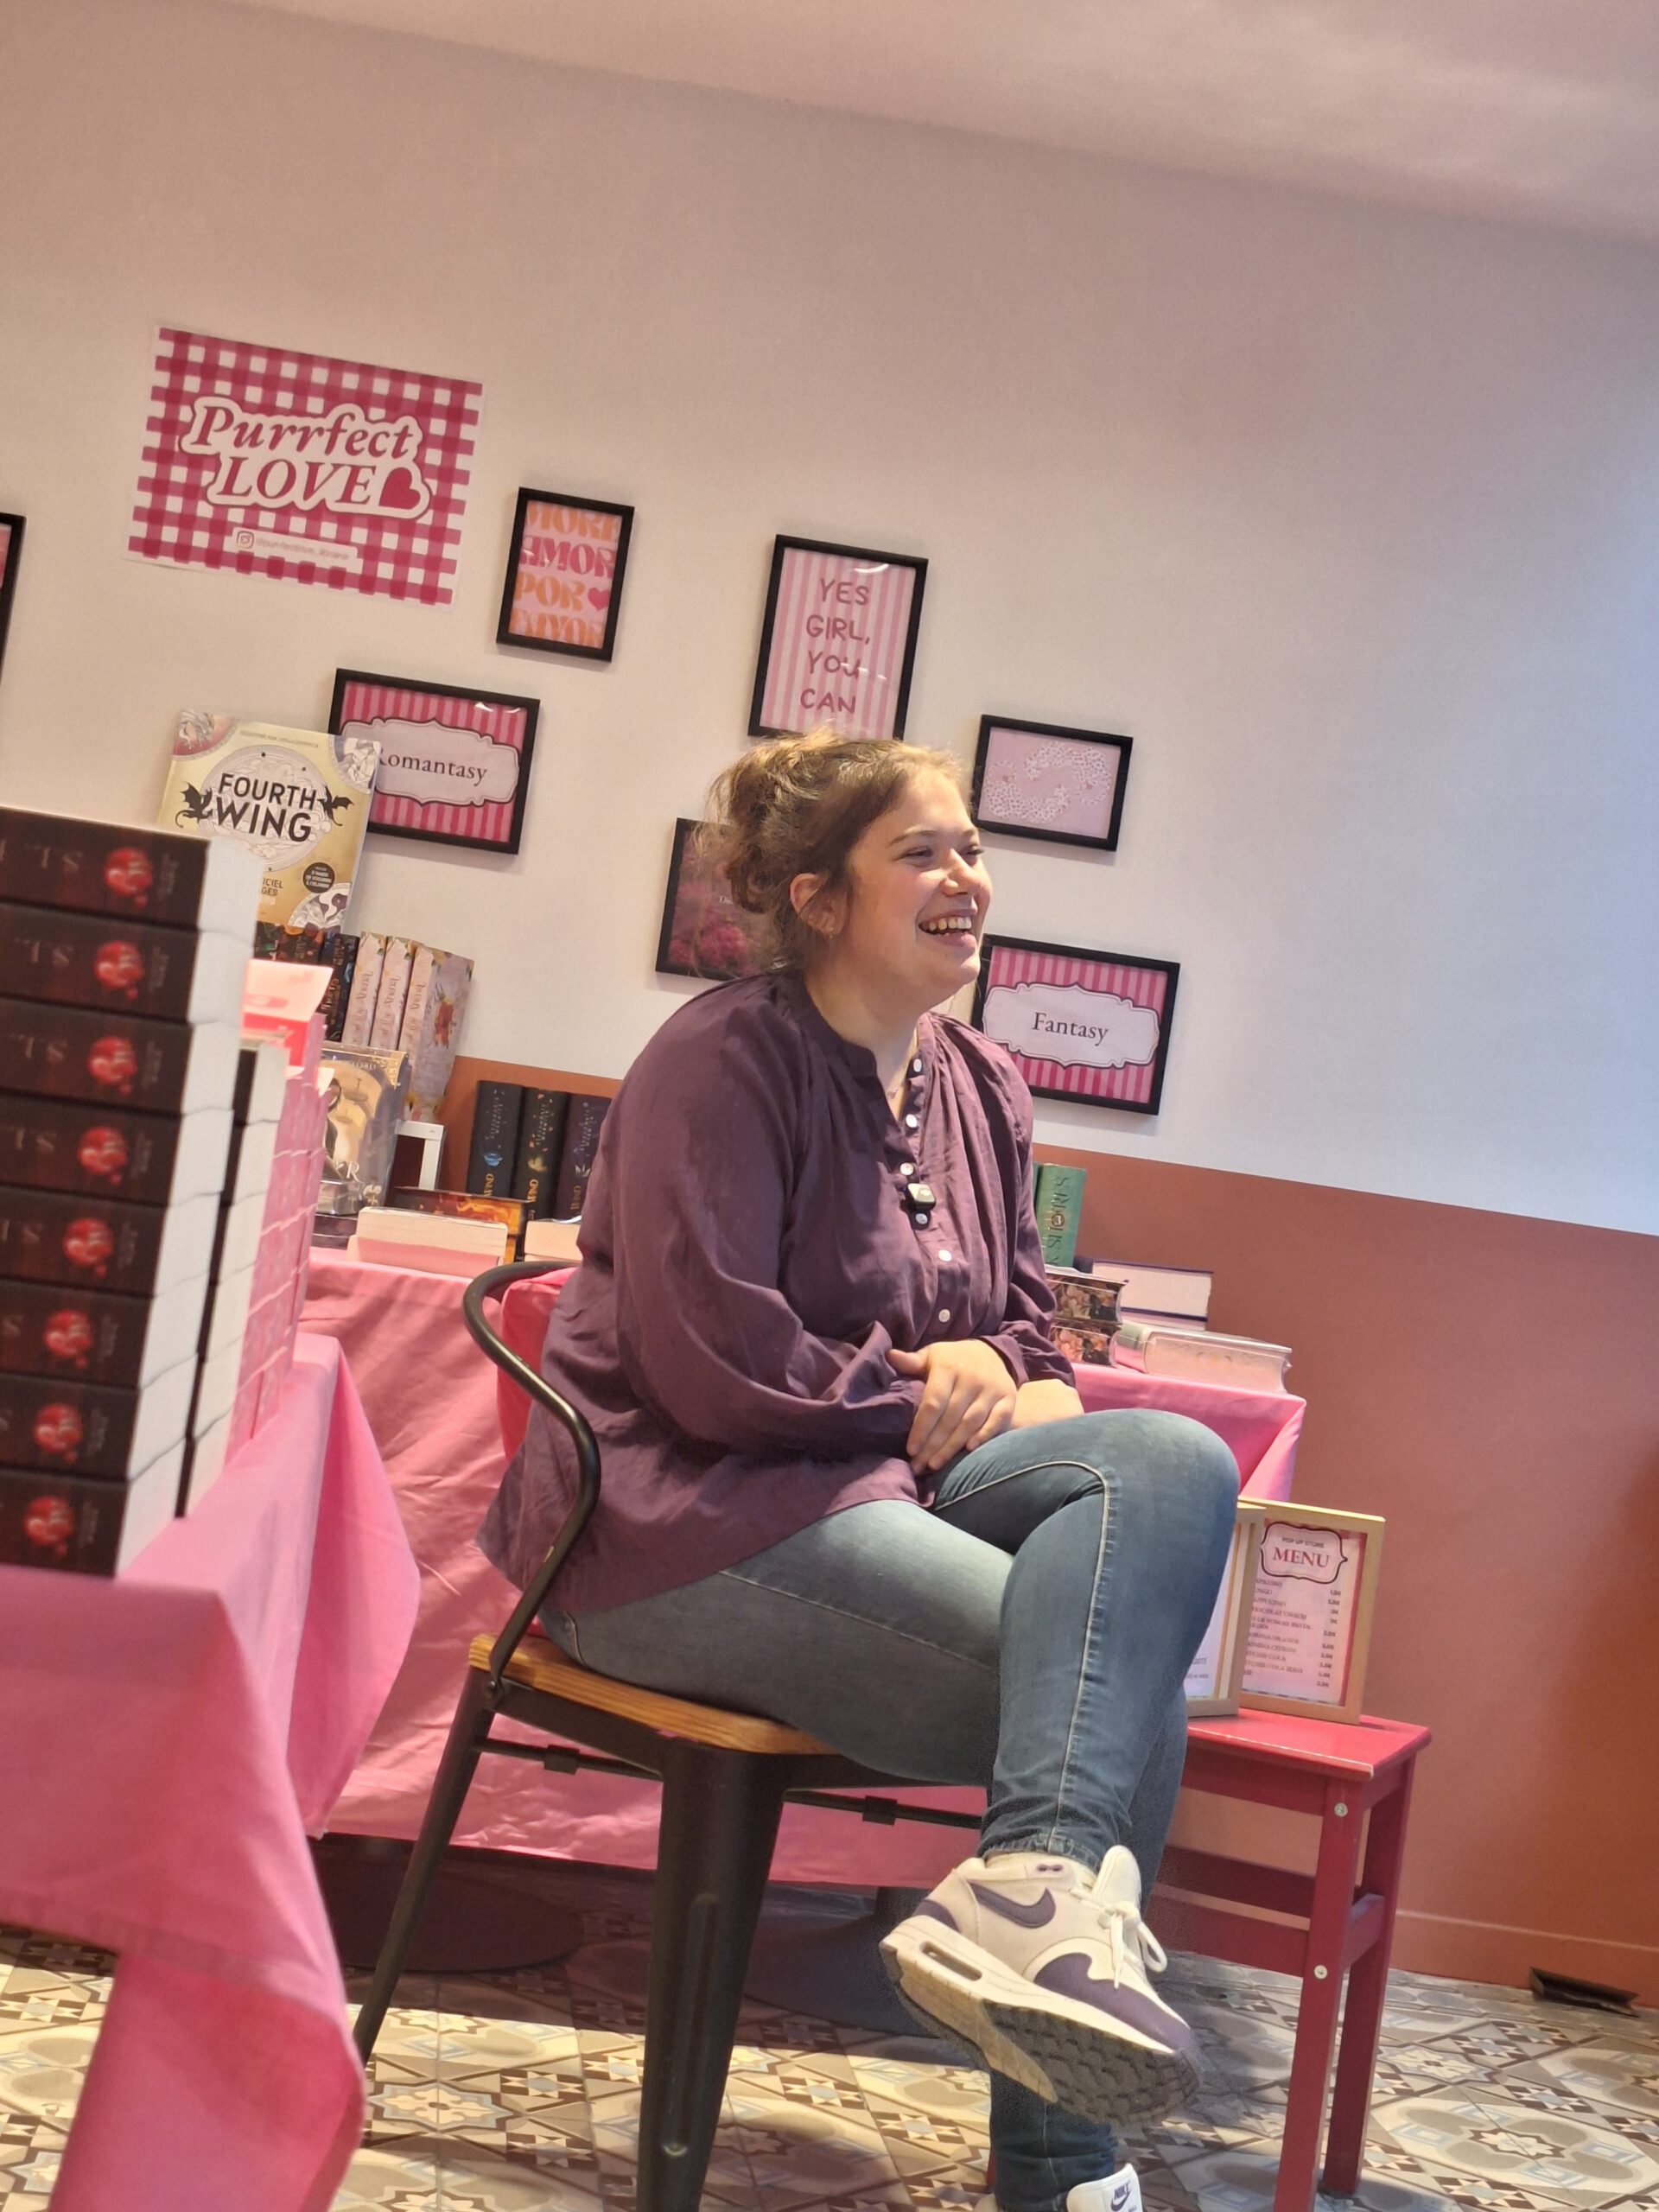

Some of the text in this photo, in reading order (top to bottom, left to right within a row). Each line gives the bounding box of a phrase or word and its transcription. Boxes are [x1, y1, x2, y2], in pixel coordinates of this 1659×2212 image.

[189, 404, 414, 460] Purrfect
[216, 455, 377, 505] LOVE
[513, 570, 586, 613] POR
[820, 577, 870, 607] YES
[805, 613, 871, 645] GIRL,
[808, 650, 861, 680] YOU
[799, 688, 856, 715] CAN
[378, 747, 488, 787] omantasy
[219, 772, 317, 811] FOURTH
[216, 797, 312, 843] WING
[261, 886, 278, 897] GES
[262, 877, 284, 889] ICIEL
[1031, 1011, 1109, 1047] Fantasy
[1272, 1546, 1331, 1568] MENU
